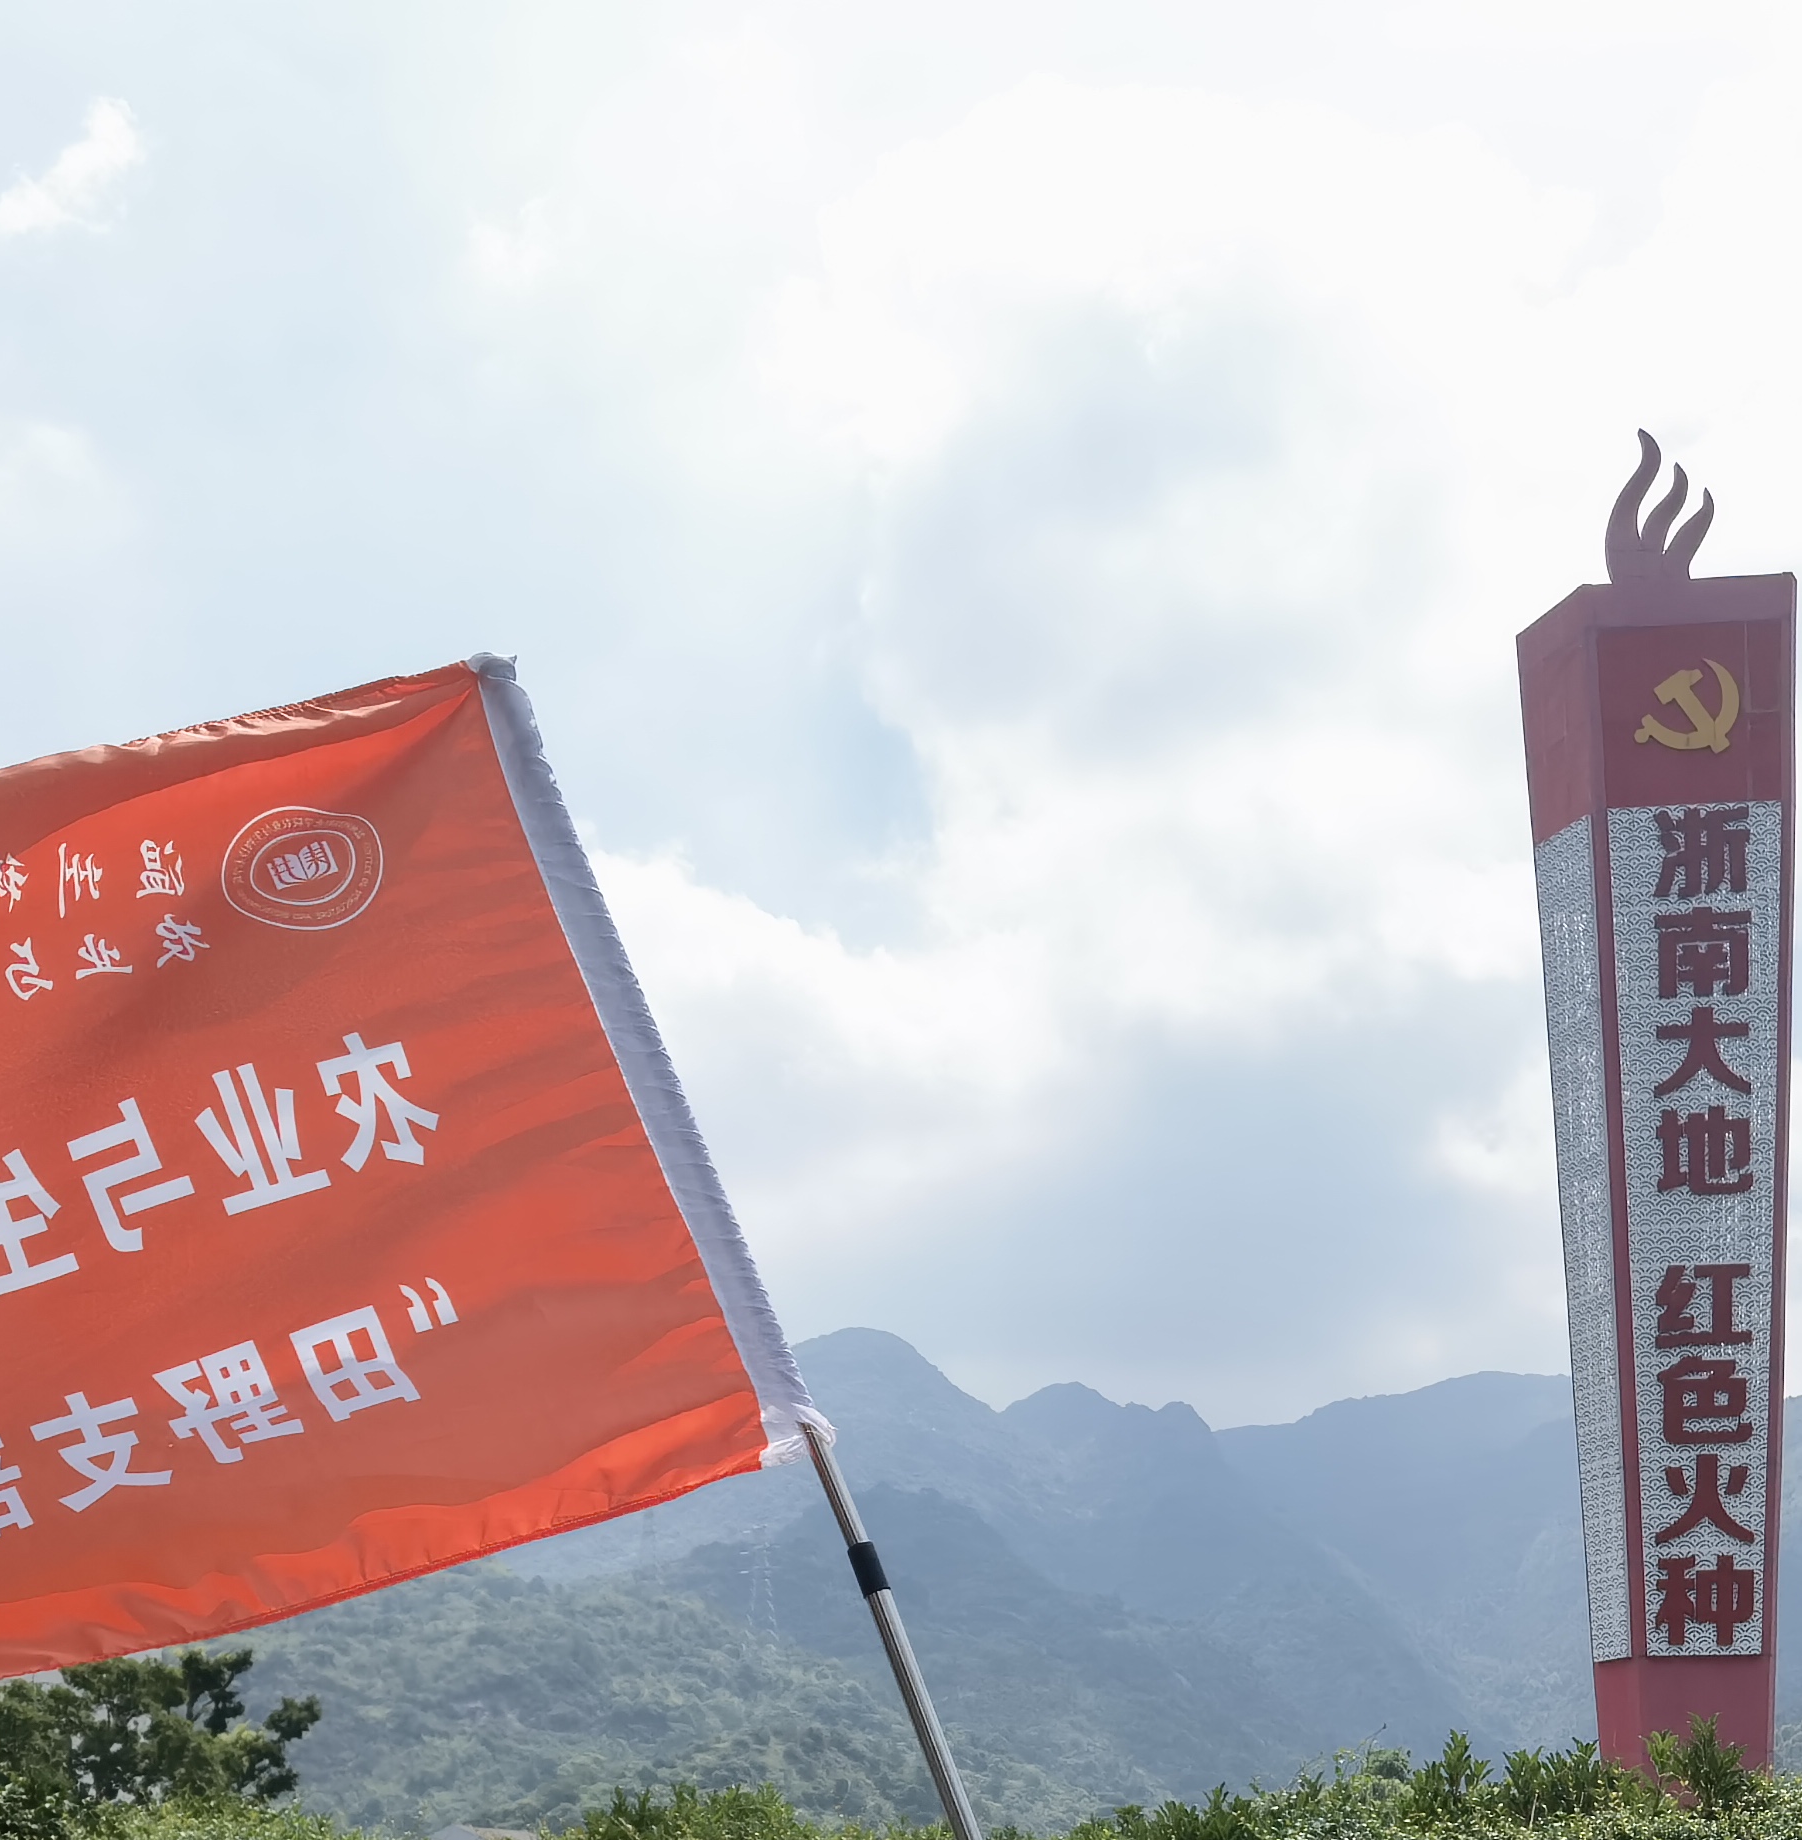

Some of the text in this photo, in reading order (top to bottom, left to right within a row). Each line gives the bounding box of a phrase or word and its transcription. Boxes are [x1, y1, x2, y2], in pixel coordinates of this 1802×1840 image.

[1653, 804, 1755, 1647] 浙南大地 红色火种
